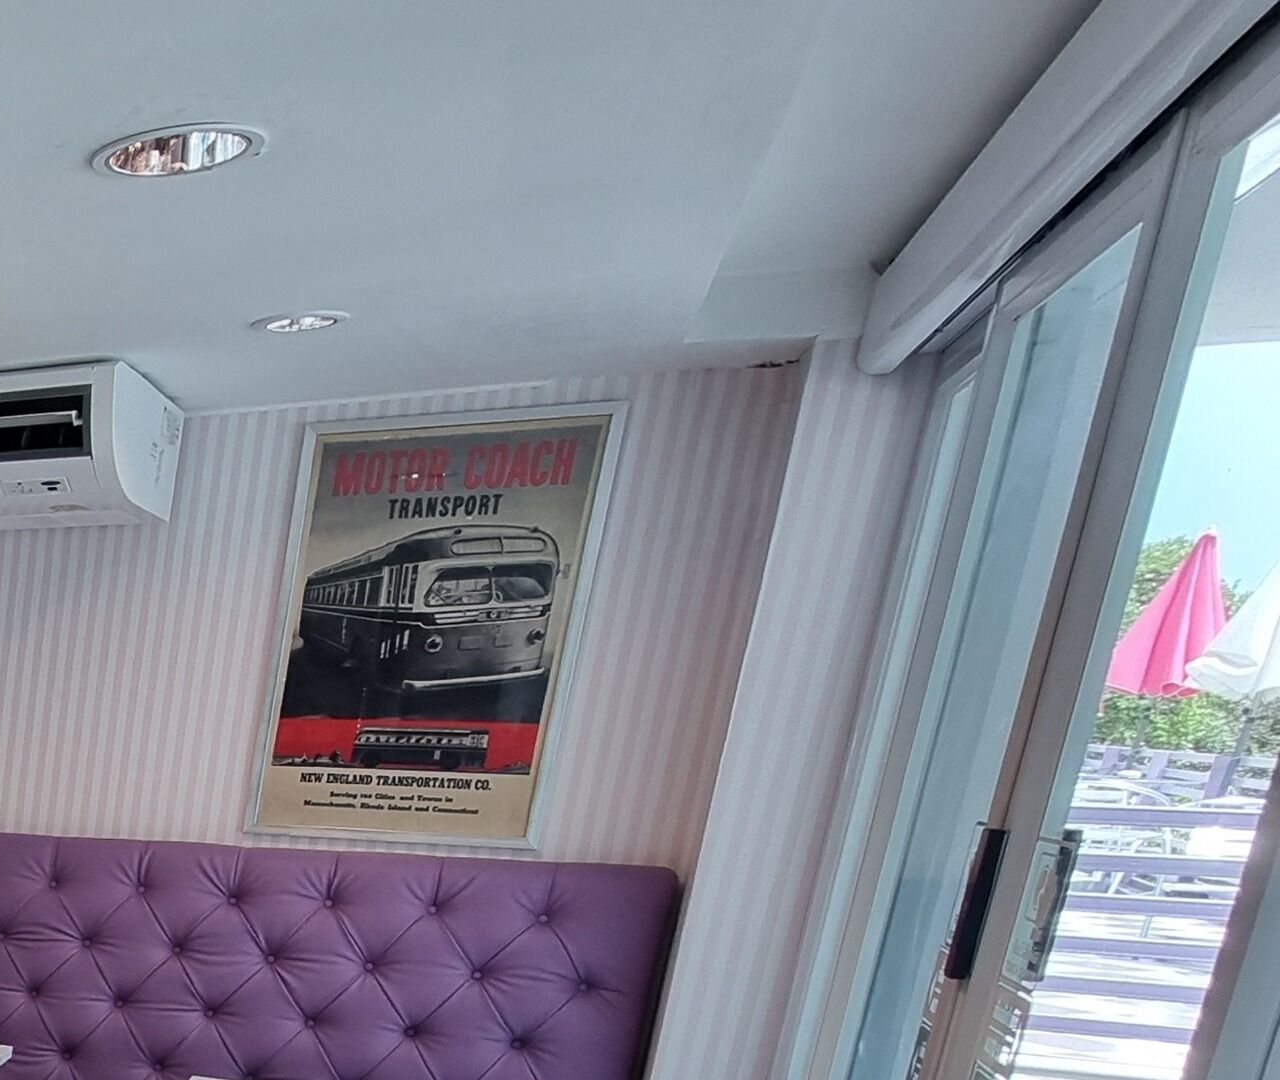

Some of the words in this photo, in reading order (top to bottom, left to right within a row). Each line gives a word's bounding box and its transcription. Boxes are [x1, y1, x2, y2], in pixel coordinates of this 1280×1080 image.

[332, 446, 452, 497] MOTOR
[463, 437, 578, 491] COACH
[388, 493, 504, 520] TRANSPORT
[299, 772, 324, 784] NEW
[325, 773, 373, 786] ENGLAND
[375, 775, 473, 790] TRANSPORTATION
[474, 779, 492, 791] CO.
